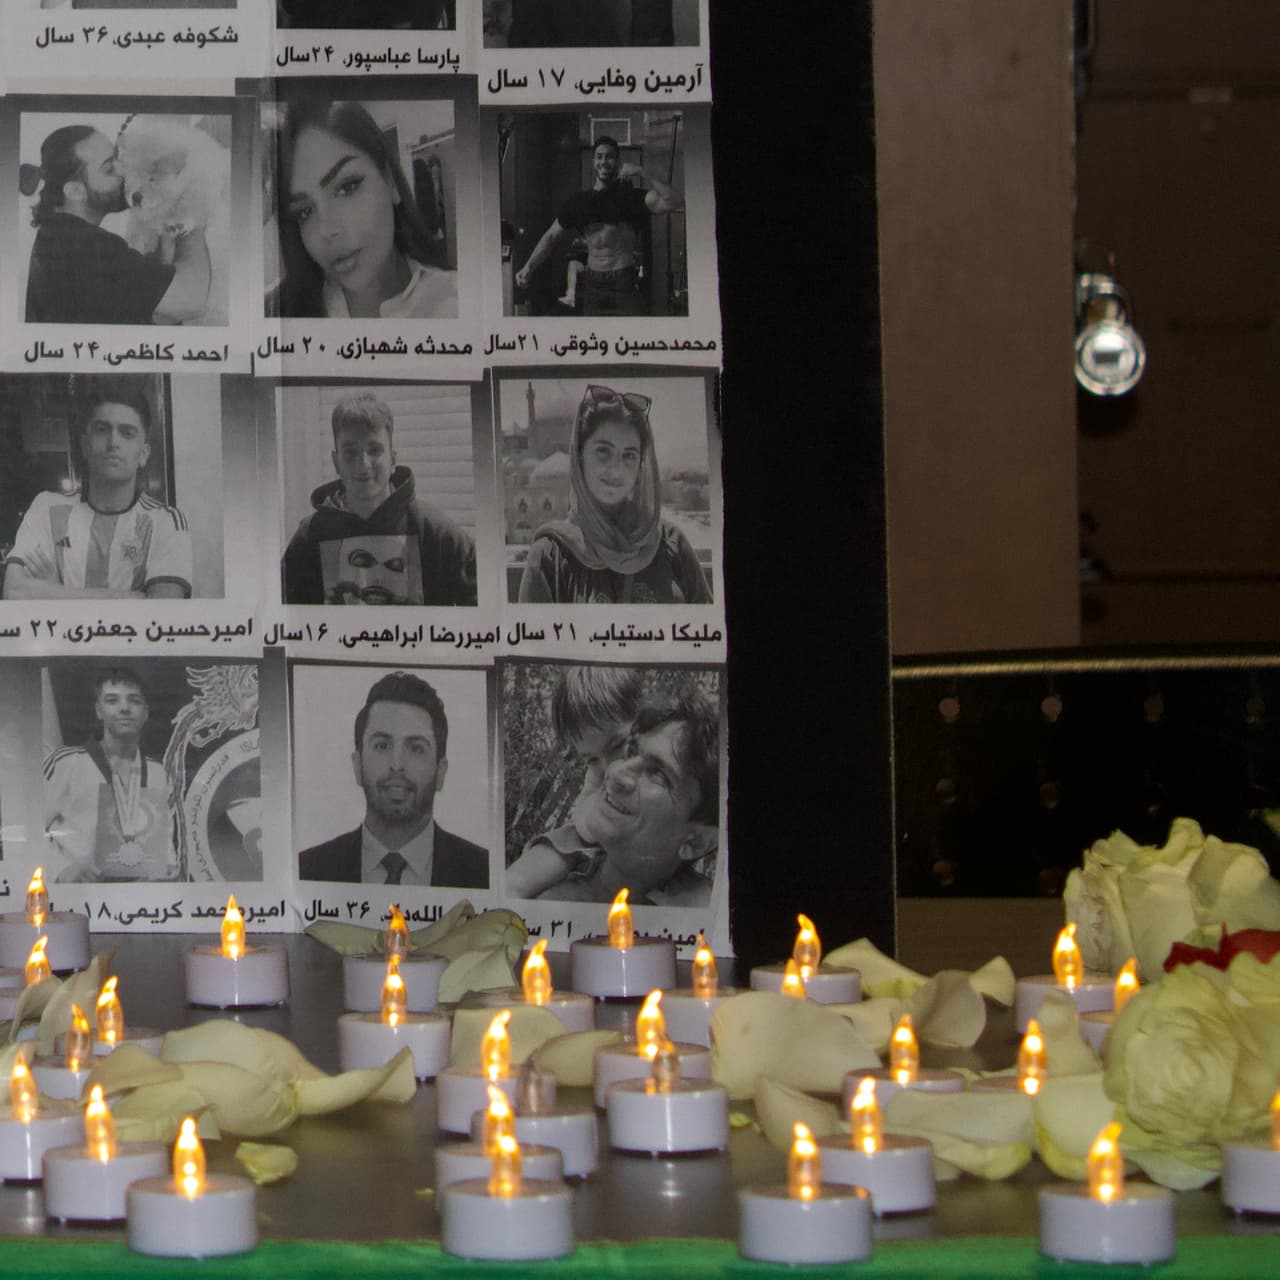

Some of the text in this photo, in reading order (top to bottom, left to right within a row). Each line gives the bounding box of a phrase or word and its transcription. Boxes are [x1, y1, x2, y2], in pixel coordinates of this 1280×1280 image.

[36, 27, 74, 48] سال
[83, 26, 108, 43] ۳۶
[173, 26, 238, 48] شکوفه
[488, 68, 528, 94] سال
[539, 68, 565, 88] ۱۷
[644, 63, 702, 93] آرمین
[24, 341, 64, 363] سال
[73, 341, 99, 359] ۲۴
[182, 345, 228, 361] احمد
[257, 336, 294, 359] سال
[302, 336, 325, 354] ۲۰
[414, 335, 472, 355] محدثه
[30, 620, 57, 637] ۲۲
[146, 618, 252, 642] امیرحسین
[507, 622, 545, 646] سال
[553, 623, 576, 640] ۲۱
[672, 623, 722, 642] ملیکا
